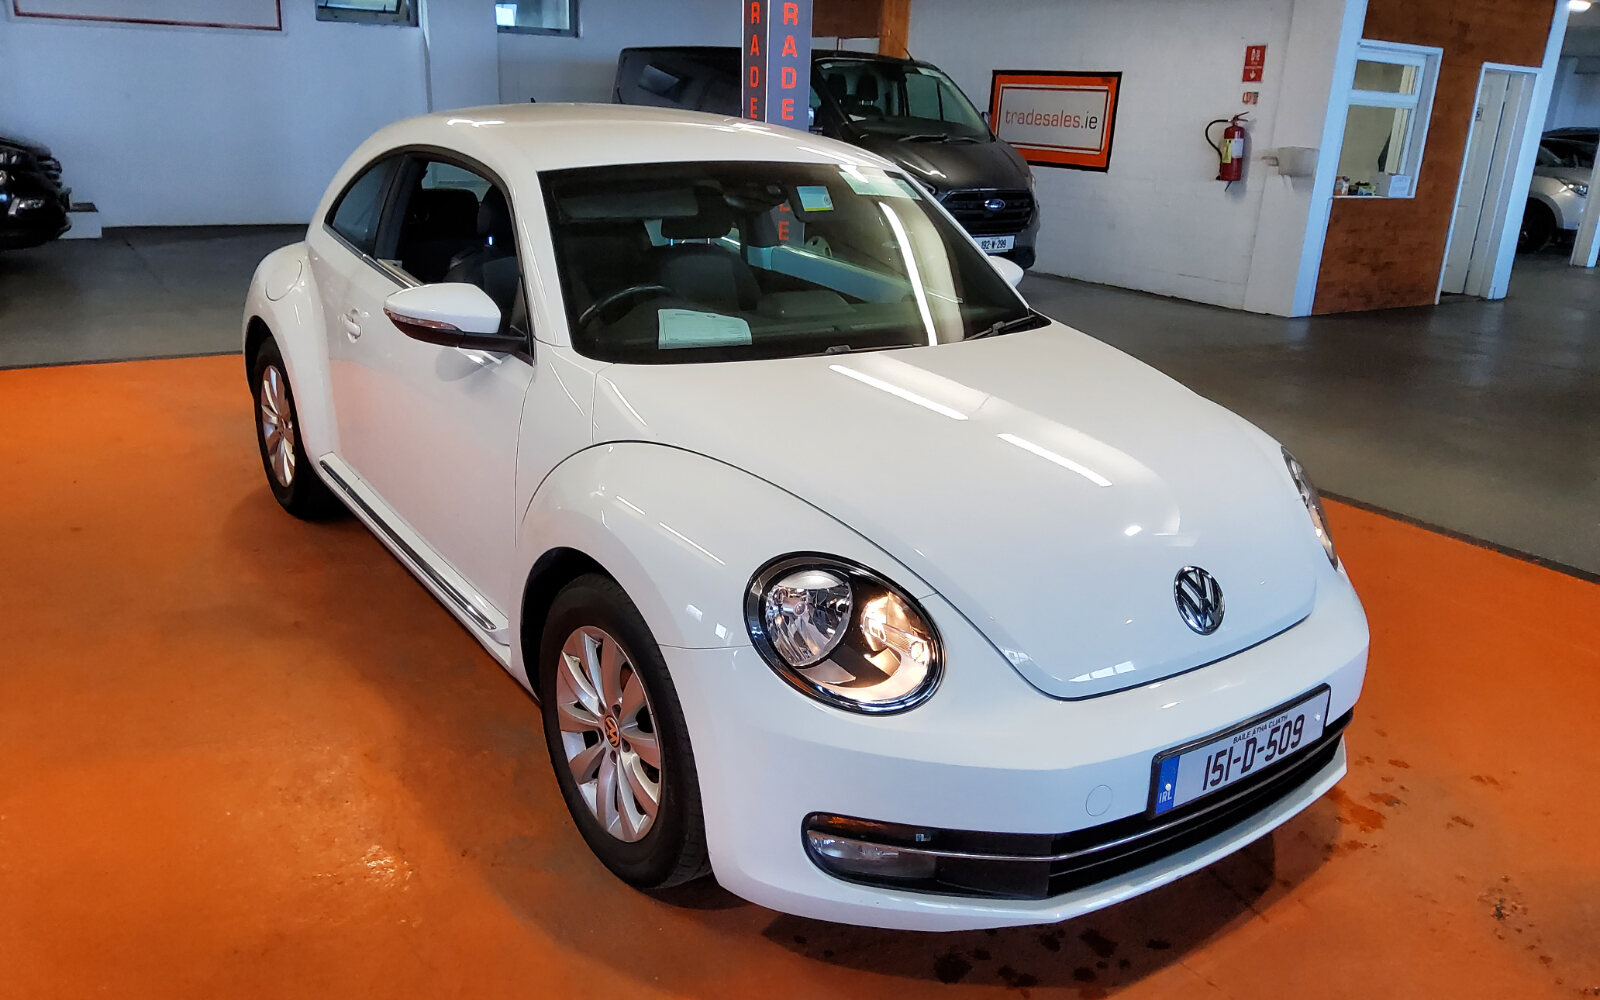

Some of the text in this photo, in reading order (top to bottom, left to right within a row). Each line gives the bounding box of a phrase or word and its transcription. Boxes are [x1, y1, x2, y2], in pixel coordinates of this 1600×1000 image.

[1005, 108, 1098, 130] tradesales.ie
[1233, 731, 1252, 744] BAILE
[1268, 714, 1289, 729] CLIATH
[1202, 713, 1305, 791] 151-D-509
[1158, 790, 1172, 804] IRL
